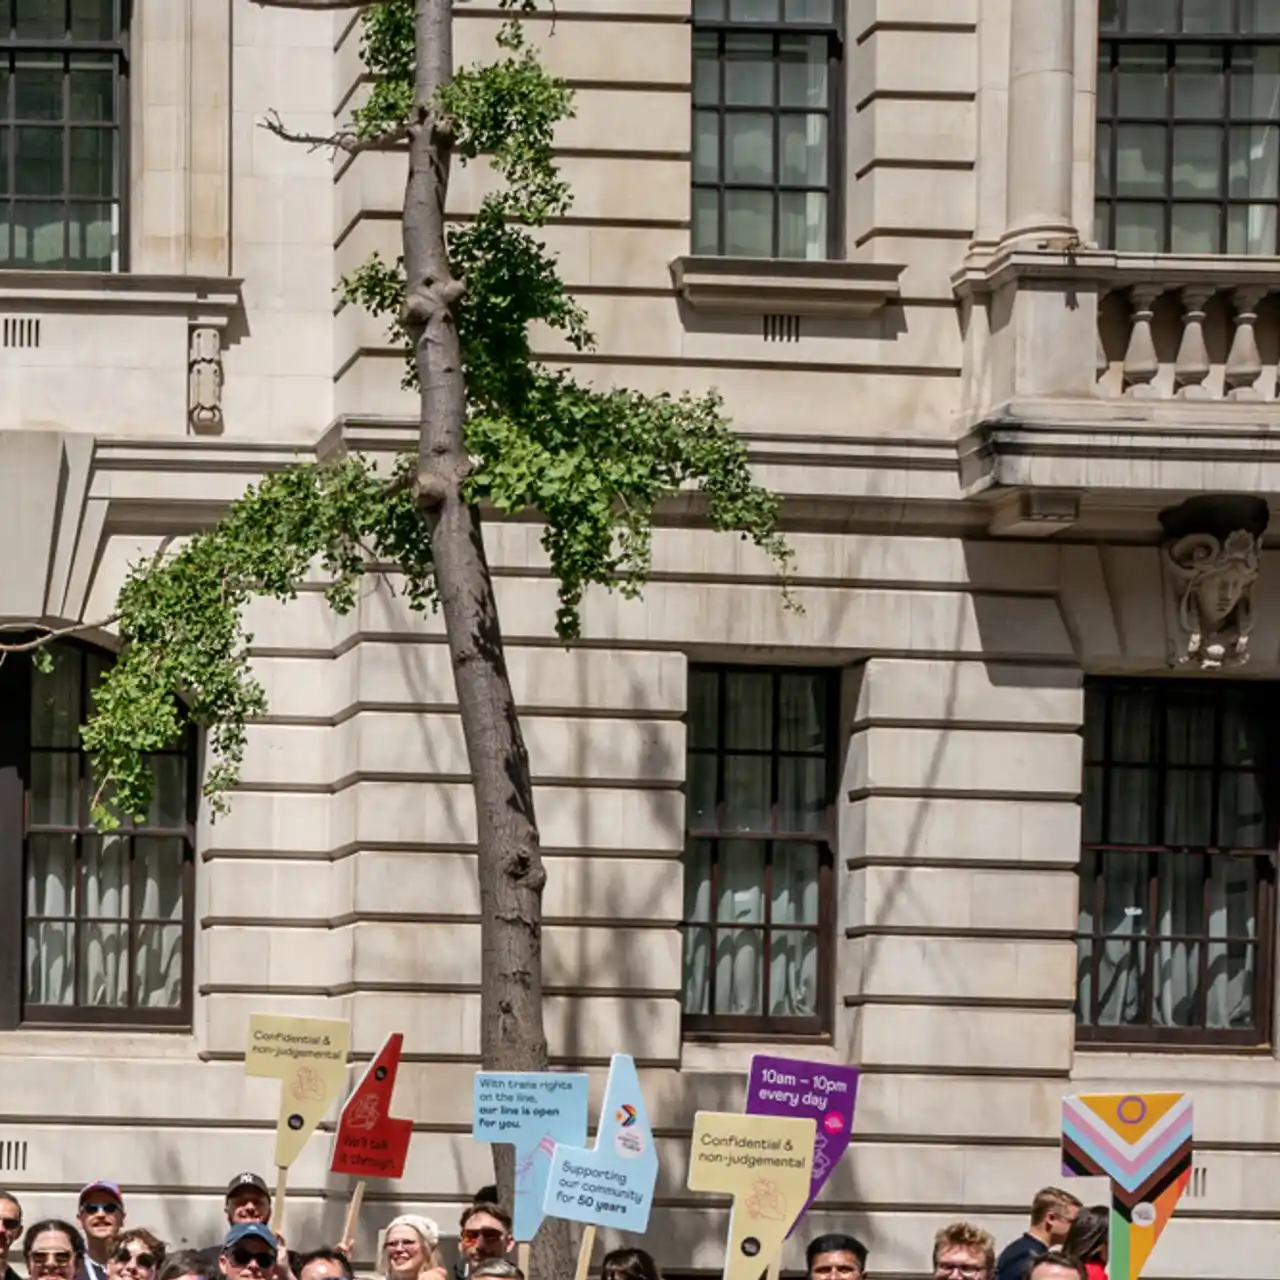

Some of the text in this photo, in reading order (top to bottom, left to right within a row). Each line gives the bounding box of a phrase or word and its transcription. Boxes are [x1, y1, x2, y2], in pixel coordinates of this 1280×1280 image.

[253, 1030, 331, 1045] Confidential &
[252, 1044, 341, 1059] non-judgemental
[480, 1079, 503, 1089] With
[539, 1080, 572, 1091] rights
[762, 1069, 848, 1093] 10am 10pm
[498, 1092, 514, 1102] the
[759, 1088, 828, 1110] every day
[479, 1106, 559, 1118] our line is open
[479, 1119, 521, 1131] for you.
[700, 1133, 793, 1151] Confidential &
[698, 1152, 805, 1169] non-judgemental
[562, 1159, 627, 1184] Supporting
[559, 1179, 644, 1204] our community
[556, 1190, 627, 1216] for 50 years
